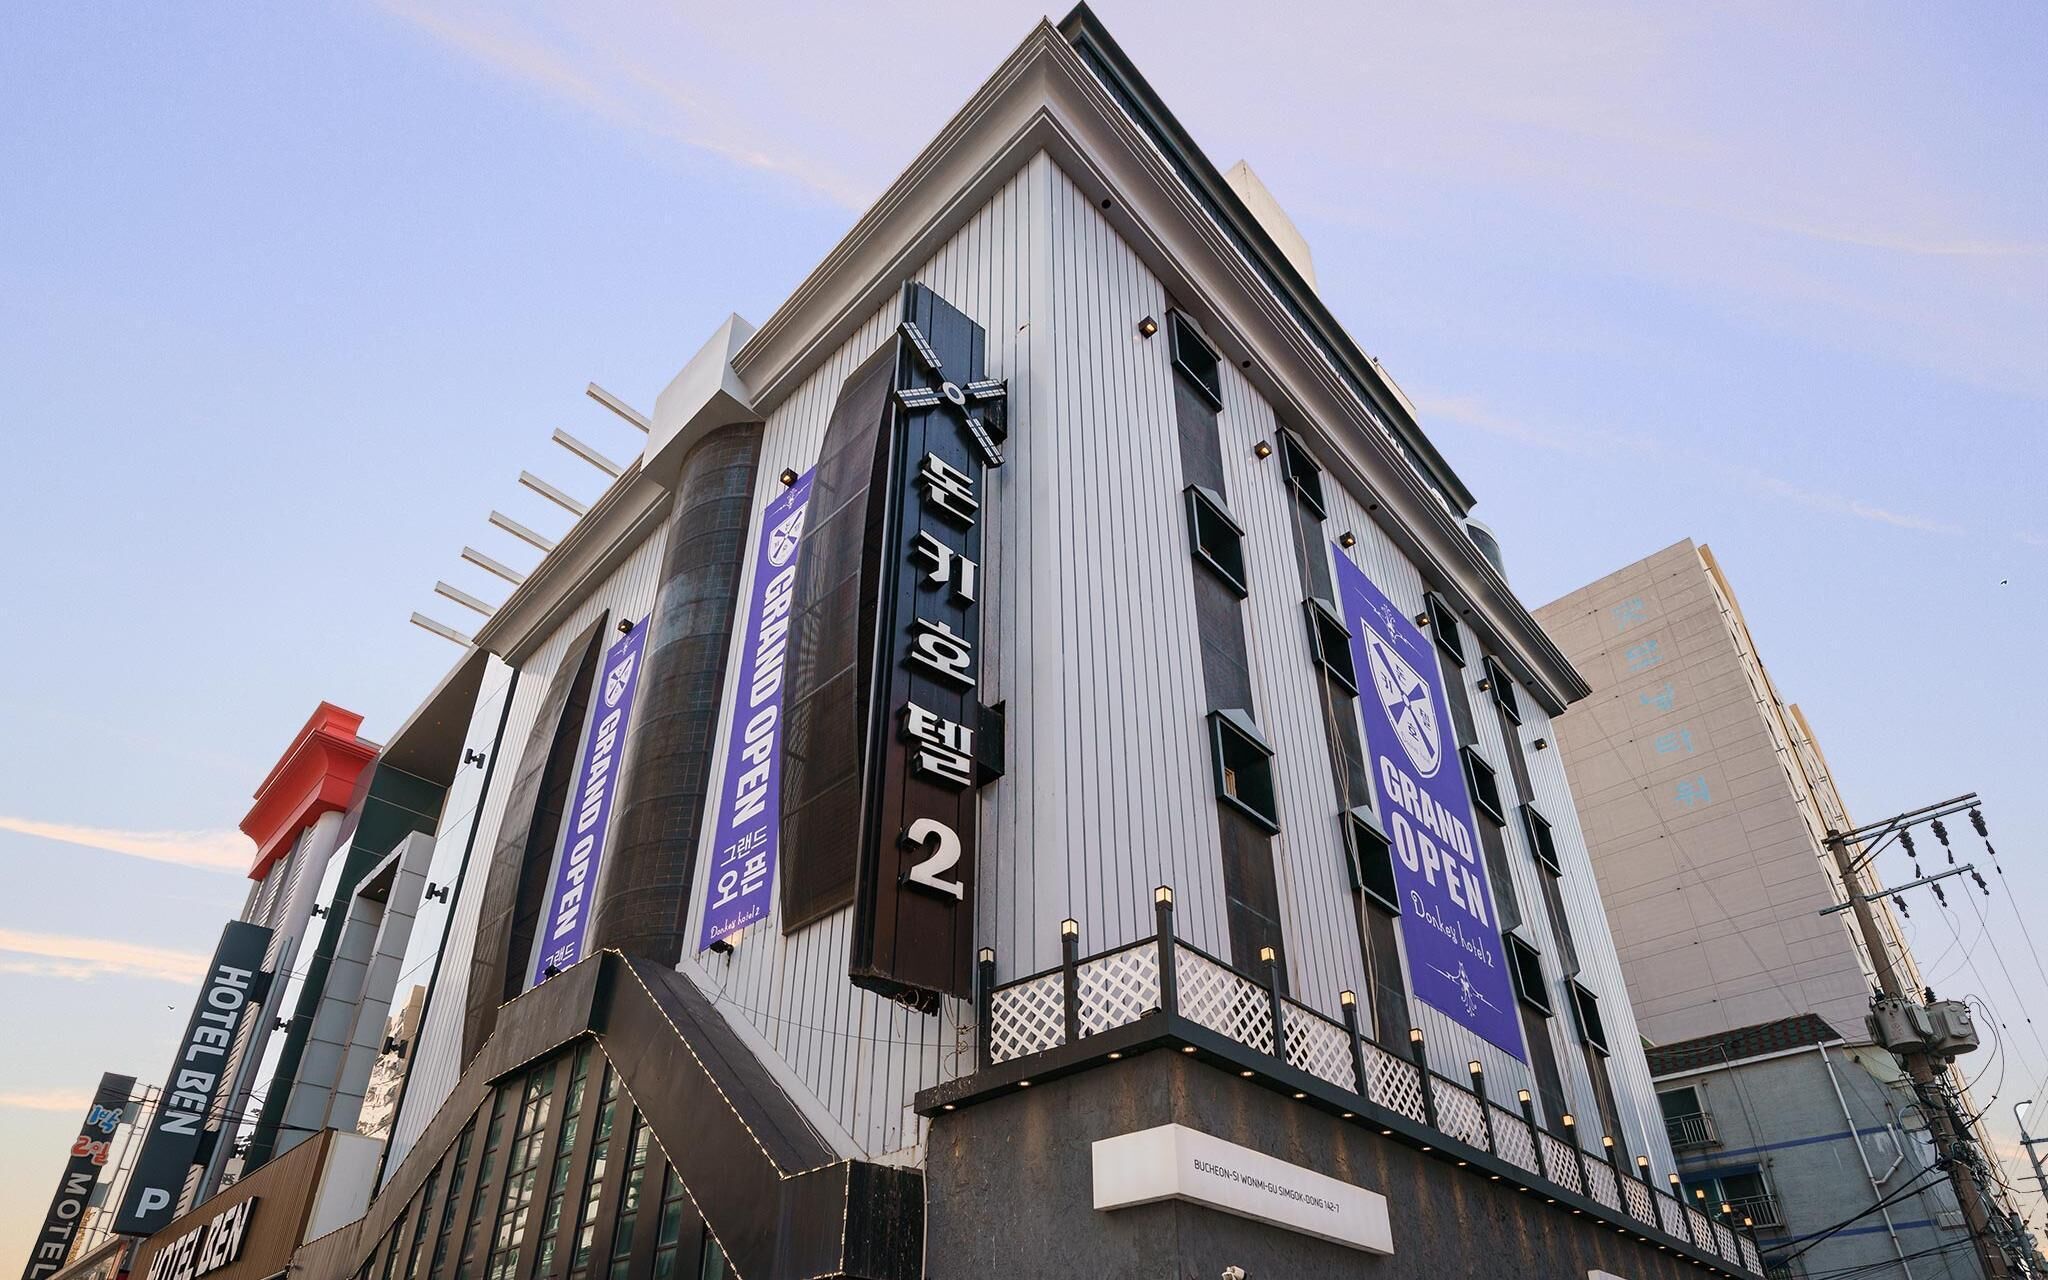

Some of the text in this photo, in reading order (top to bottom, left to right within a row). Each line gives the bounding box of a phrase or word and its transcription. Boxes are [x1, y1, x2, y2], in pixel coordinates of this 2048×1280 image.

[750, 564, 796, 708] GRAND
[905, 451, 979, 901] 돈키호텔 2
[577, 707, 622, 834] GRAND
[732, 704, 778, 829] OPEN
[1380, 755, 1475, 865] GRAND
[553, 833, 595, 940] OPEN
[712, 851, 768, 911] 오픈
[720, 825, 768, 868] 그랜드
[1391, 811, 1489, 929] OPEN
[159, 964, 253, 1137] HOTEL BEN
[71, 1135, 111, 1167] 2일
[135, 1187, 171, 1219] P
[1194, 1159, 1239, 1182] BUCHEON-SI
[1240, 1175, 1278, 1195] WONMI-GU
[1278, 1185, 1324, 1209] SIMGOK-DONG
[30, 1172, 93, 1280] MOTEL
[194, 1196, 256, 1278] BEN
